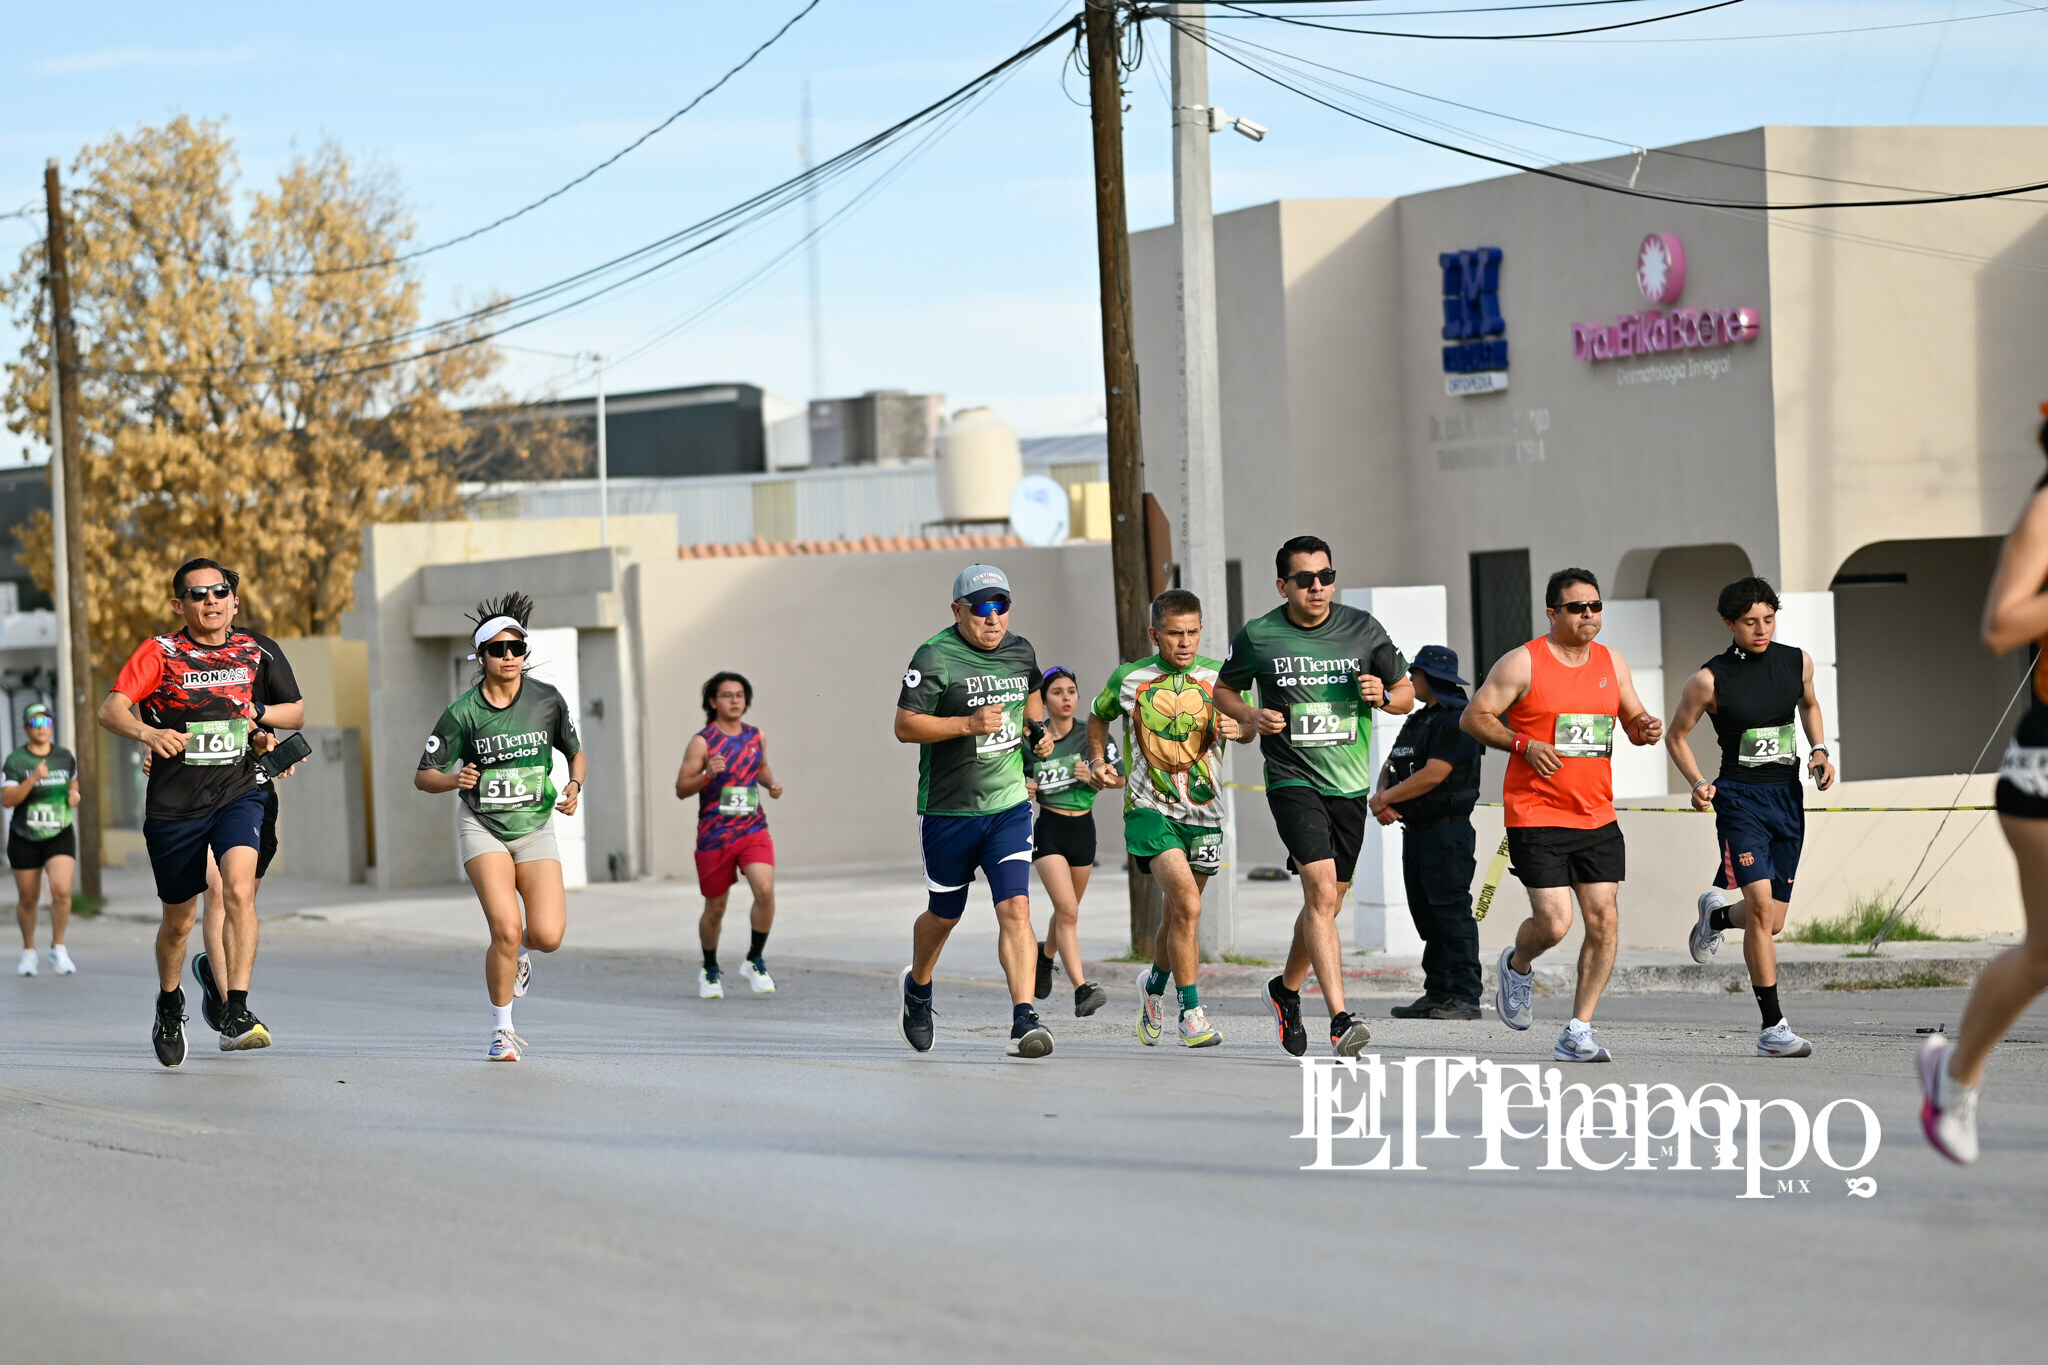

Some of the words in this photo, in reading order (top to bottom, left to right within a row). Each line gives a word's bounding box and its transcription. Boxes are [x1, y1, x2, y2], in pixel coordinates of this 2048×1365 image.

[1617, 311, 1669, 356] Erika
[1689, 355, 1731, 380] Integral
[1448, 373, 1493, 393] ORTOPEDIA
[1272, 656, 1294, 674] El
[184, 668, 249, 683] IRONCAST
[1276, 675, 1298, 687] de
[1299, 674, 1349, 686] todos
[964, 676, 984, 694] El
[967, 695, 986, 707] de
[986, 692, 1025, 704] todos
[1299, 714, 1341, 734] 129
[196, 732, 235, 752] 160
[475, 737, 492, 754] El
[492, 730, 548, 750] Tiempo
[984, 722, 1016, 745] 239
[1569, 725, 1595, 744] 24
[480, 756, 497, 764] de
[497, 747, 539, 761] todos
[1754, 738, 1780, 756] 23
[1037, 766, 1070, 785] 222
[487, 779, 527, 797] 516
[535, 775, 543, 802] MEDALLA
[730, 794, 748, 807] 52
[33, 811, 55, 822] 111
[1197, 844, 1223, 862] 530
